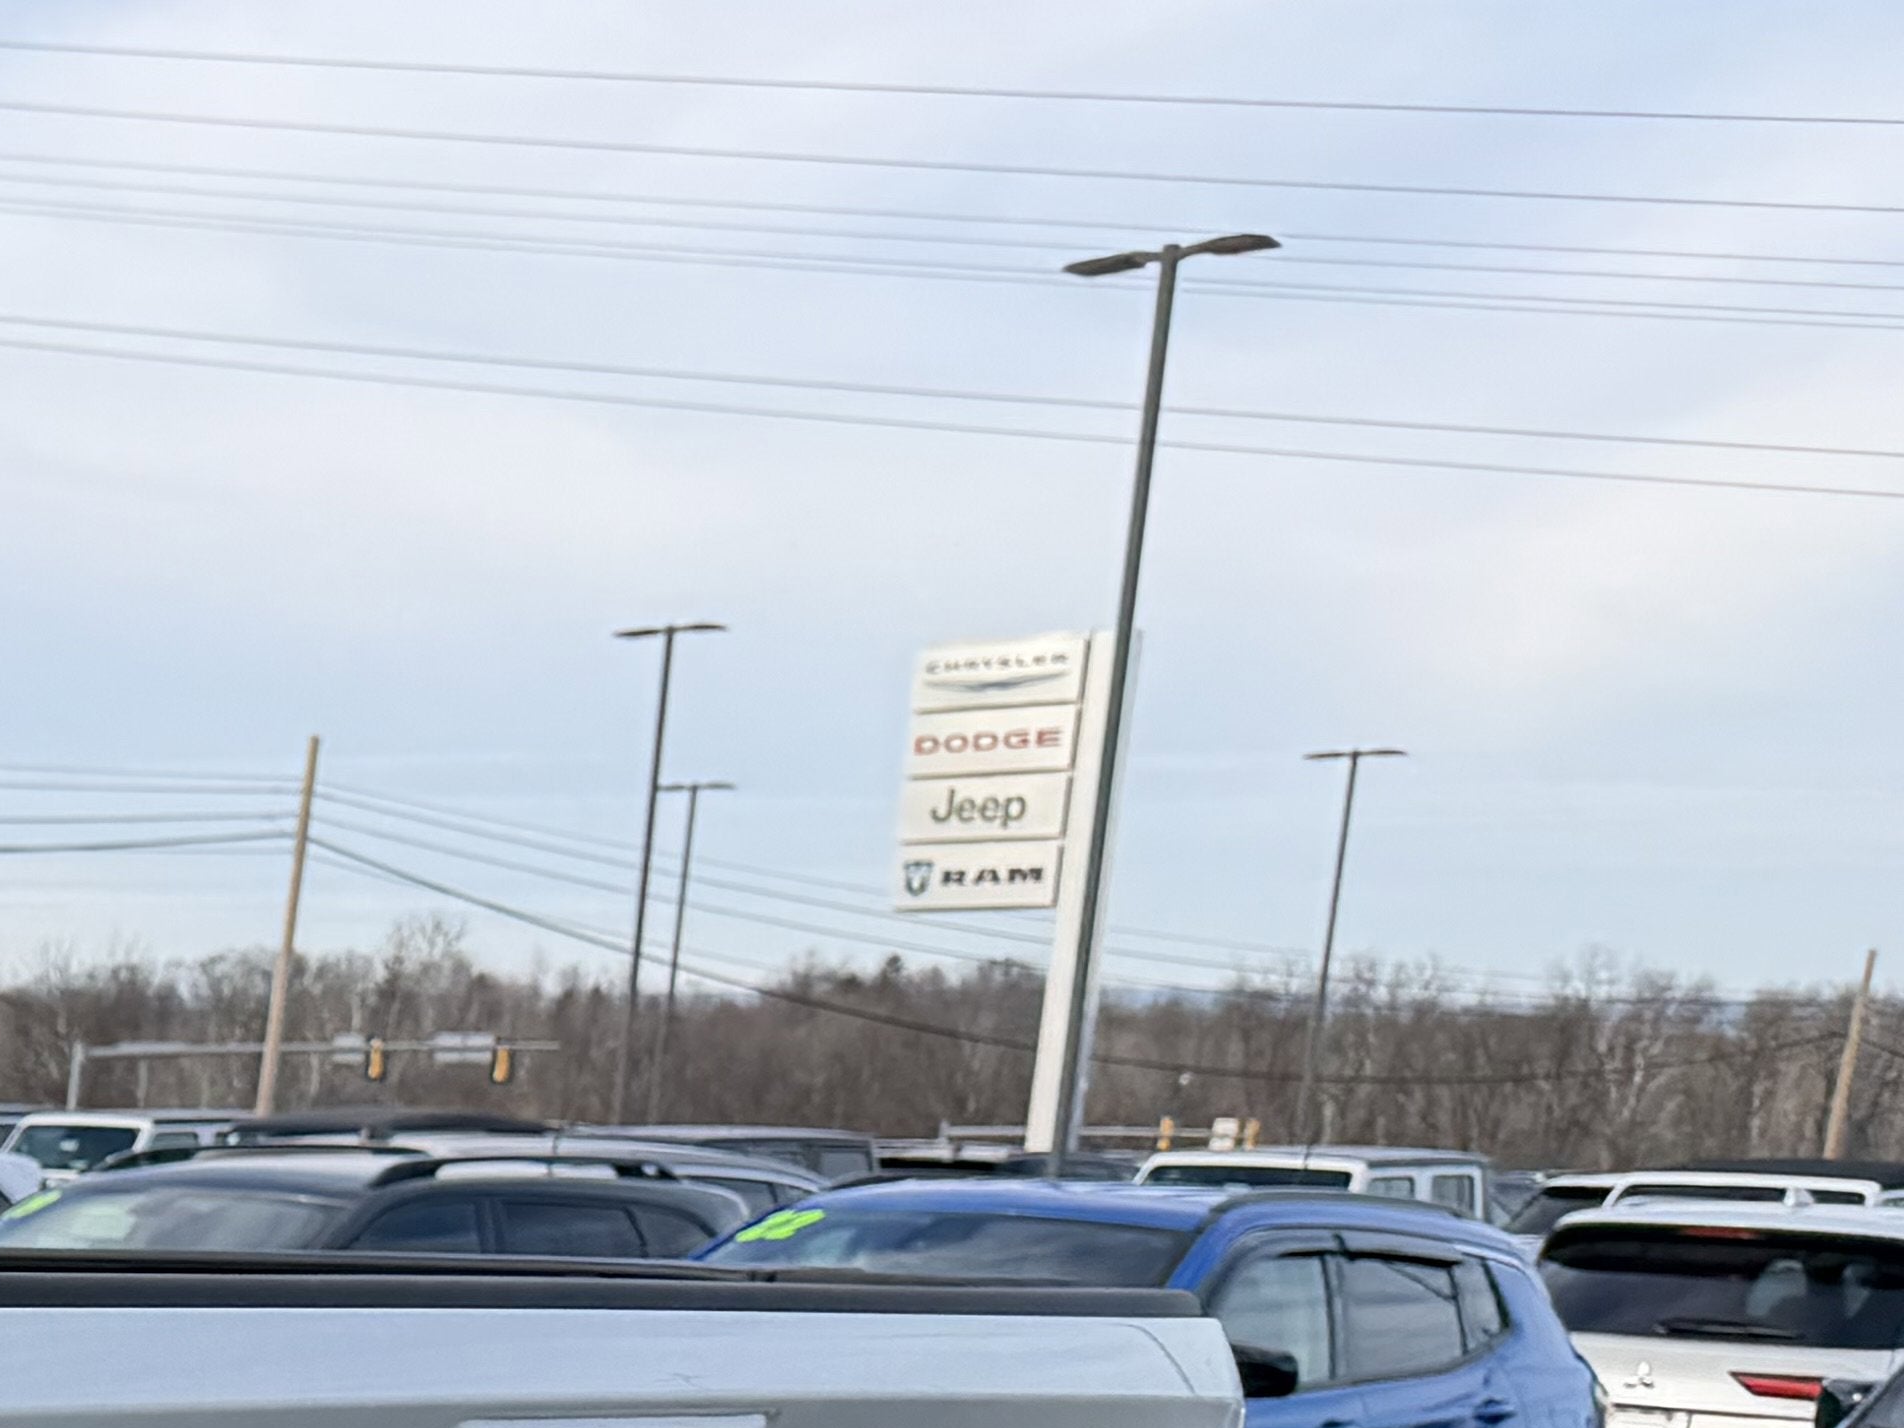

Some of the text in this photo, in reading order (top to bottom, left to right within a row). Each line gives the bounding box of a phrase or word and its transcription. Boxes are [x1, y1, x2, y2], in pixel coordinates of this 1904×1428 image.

[913, 727, 1062, 756] DODGE
[930, 788, 1027, 829] Jeep
[940, 867, 1044, 887] RAM
